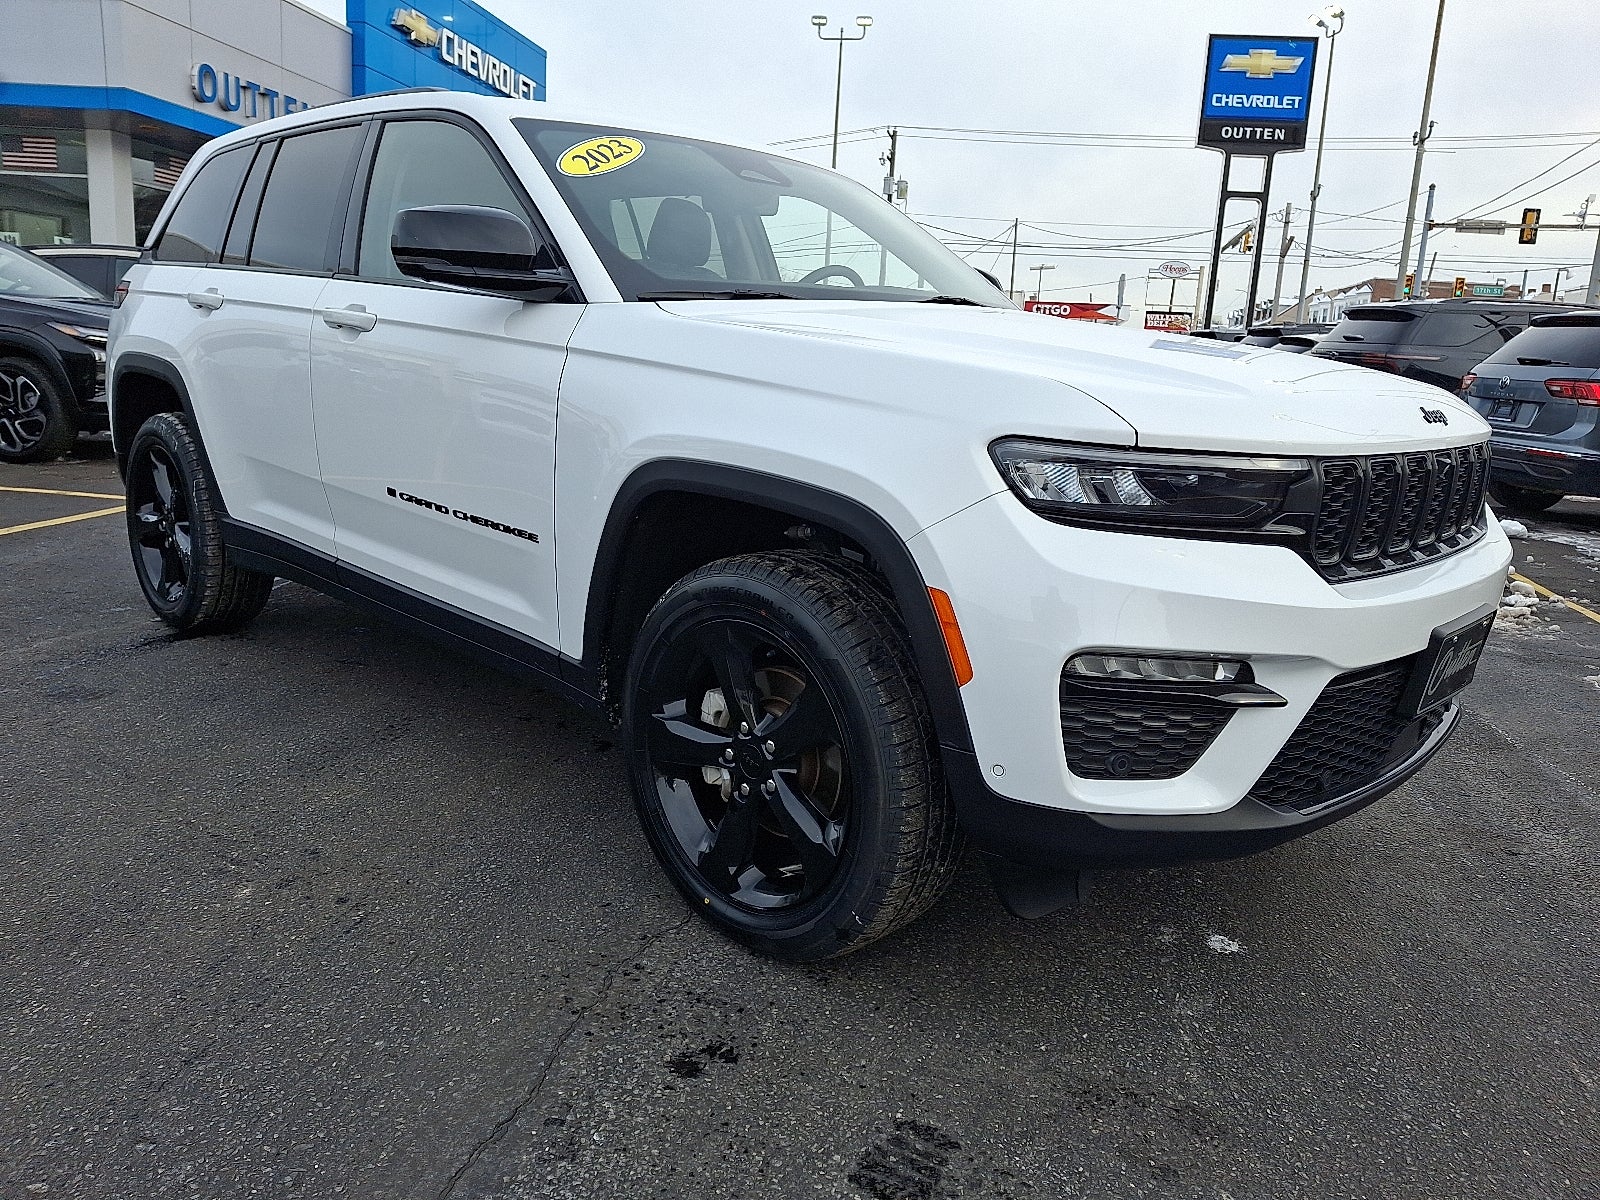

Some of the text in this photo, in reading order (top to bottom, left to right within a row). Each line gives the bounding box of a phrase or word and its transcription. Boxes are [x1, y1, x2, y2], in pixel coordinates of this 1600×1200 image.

[441, 28, 536, 100] CHEVROLET
[191, 63, 311, 118] OUTTE
[1211, 93, 1302, 109] CHEVROLET
[1221, 126, 1285, 140] OUTTEN
[571, 139, 633, 171] 2023
[1476, 287, 1491, 295] 17th
[1032, 304, 1071, 316] CITGO
[1419, 406, 1449, 426] Jeep
[399, 491, 540, 544] GRAND CHEROKEE
